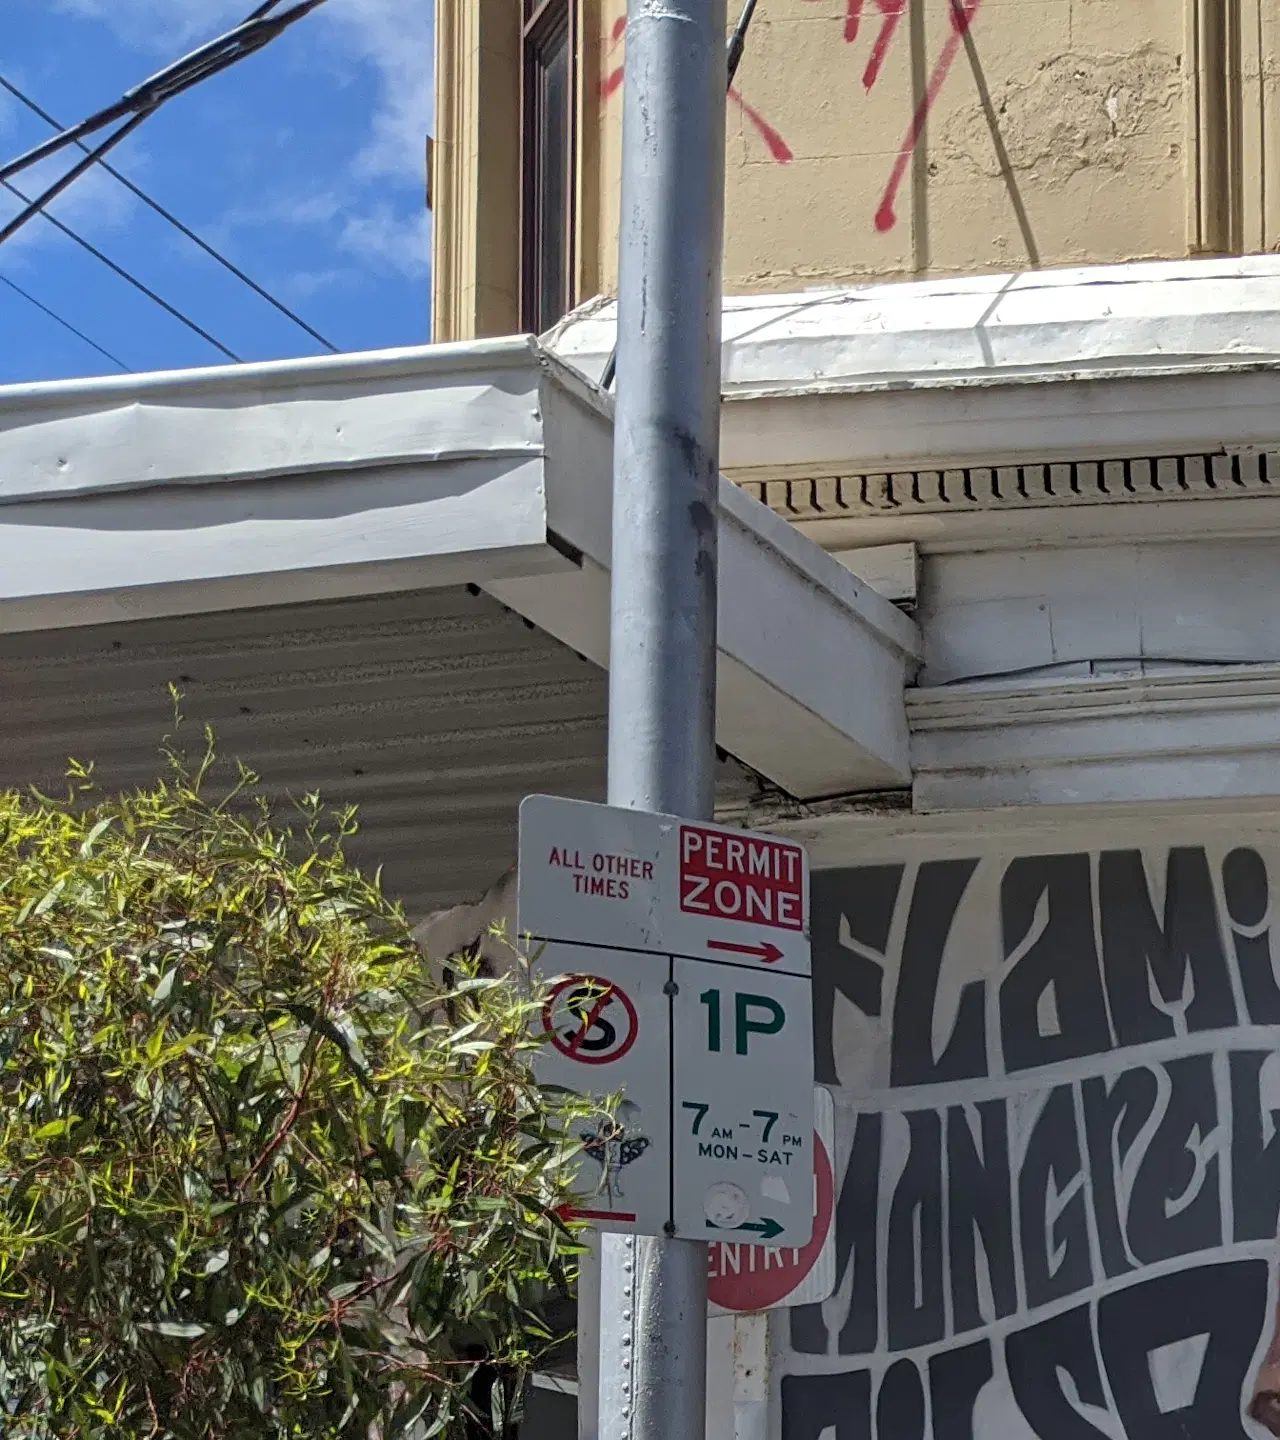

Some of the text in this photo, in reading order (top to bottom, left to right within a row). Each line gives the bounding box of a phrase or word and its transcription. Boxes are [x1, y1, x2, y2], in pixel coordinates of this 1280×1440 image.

[549, 846, 654, 880] ALL OTHER
[683, 831, 799, 883] PERMIT
[573, 874, 629, 899] TIMES
[683, 874, 801, 926] ZONE
[700, 988, 786, 1056] 1P
